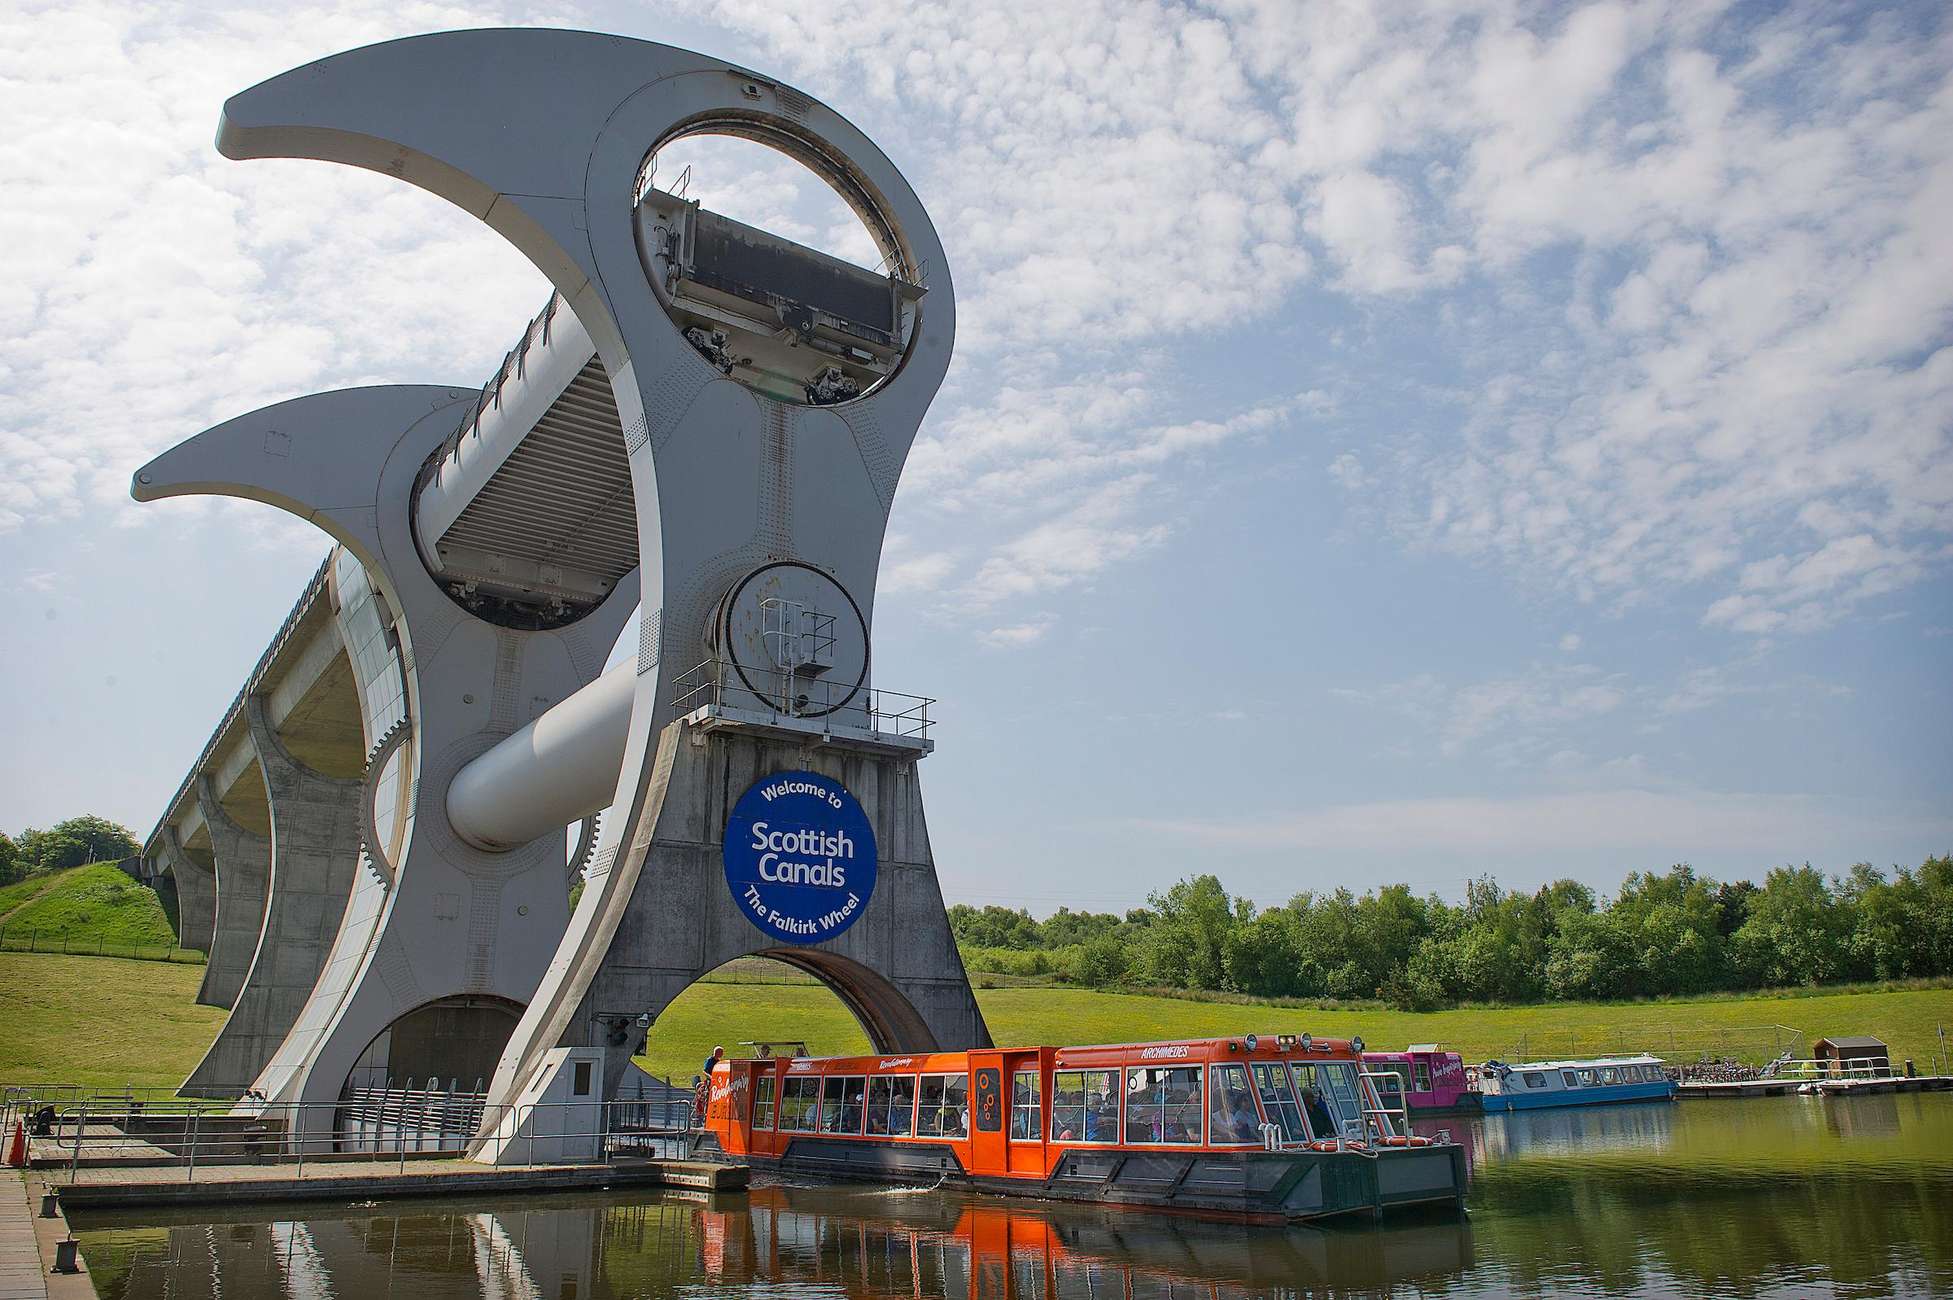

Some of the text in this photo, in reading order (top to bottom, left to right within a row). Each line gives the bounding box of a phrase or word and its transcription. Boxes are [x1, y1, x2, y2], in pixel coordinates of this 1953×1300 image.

[761, 780, 842, 809] Welcome to
[751, 821, 854, 859] Scottish
[759, 852, 845, 887] Canals
[744, 885, 860, 934] The Falkirk Wheel
[1141, 1046, 1190, 1059] ARCHIMEDES
